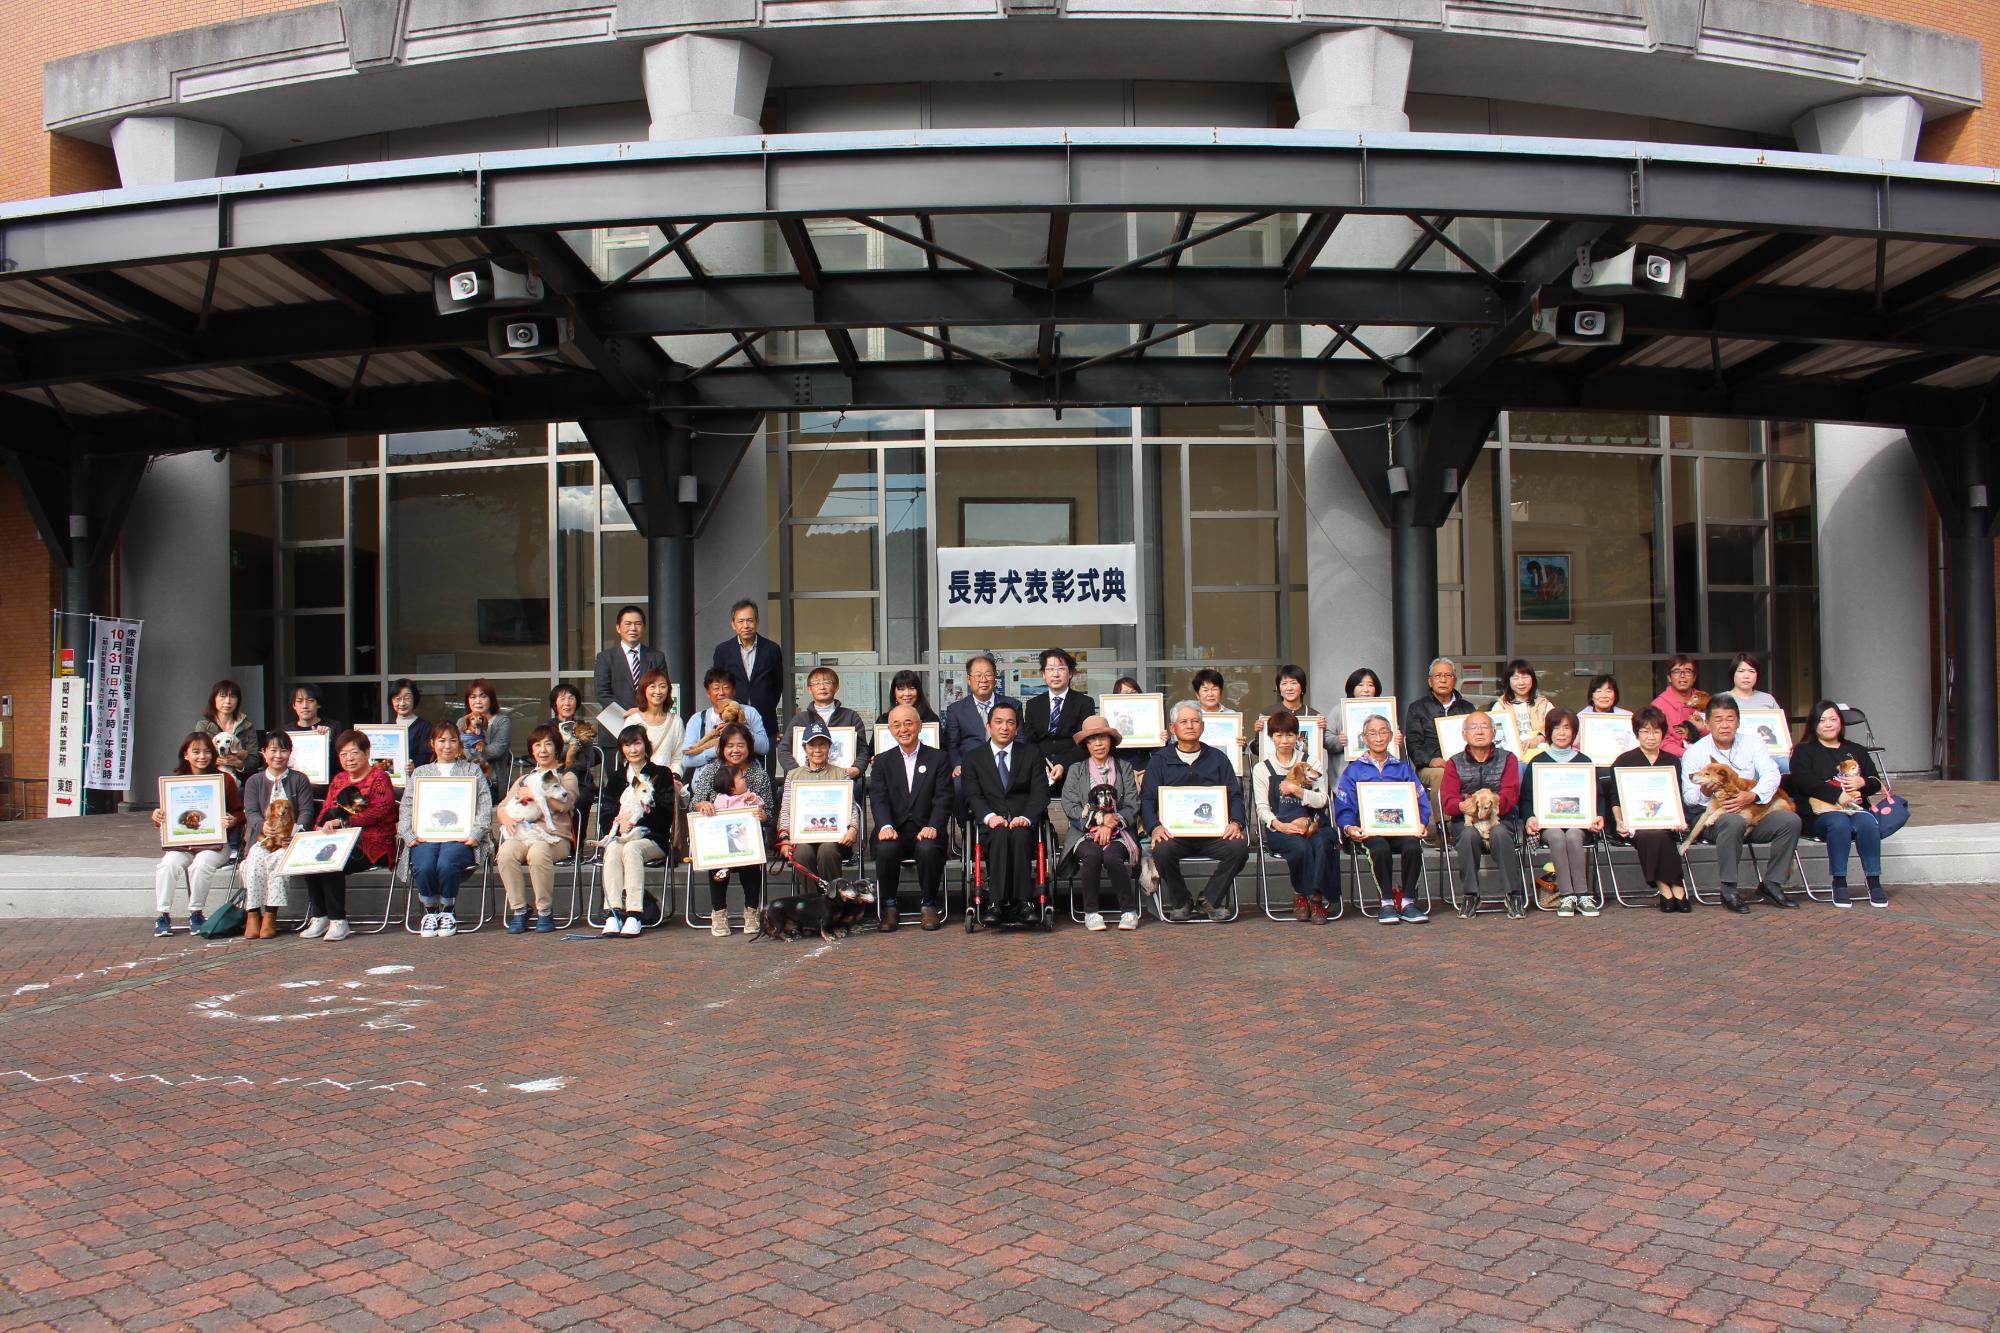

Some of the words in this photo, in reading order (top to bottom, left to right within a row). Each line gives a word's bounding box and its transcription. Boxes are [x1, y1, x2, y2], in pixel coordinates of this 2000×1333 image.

[948, 566, 1127, 605] 長寿犬表彰式典
[58, 681, 70, 767] 期日前投票所
[57, 779, 72, 793] 東館
